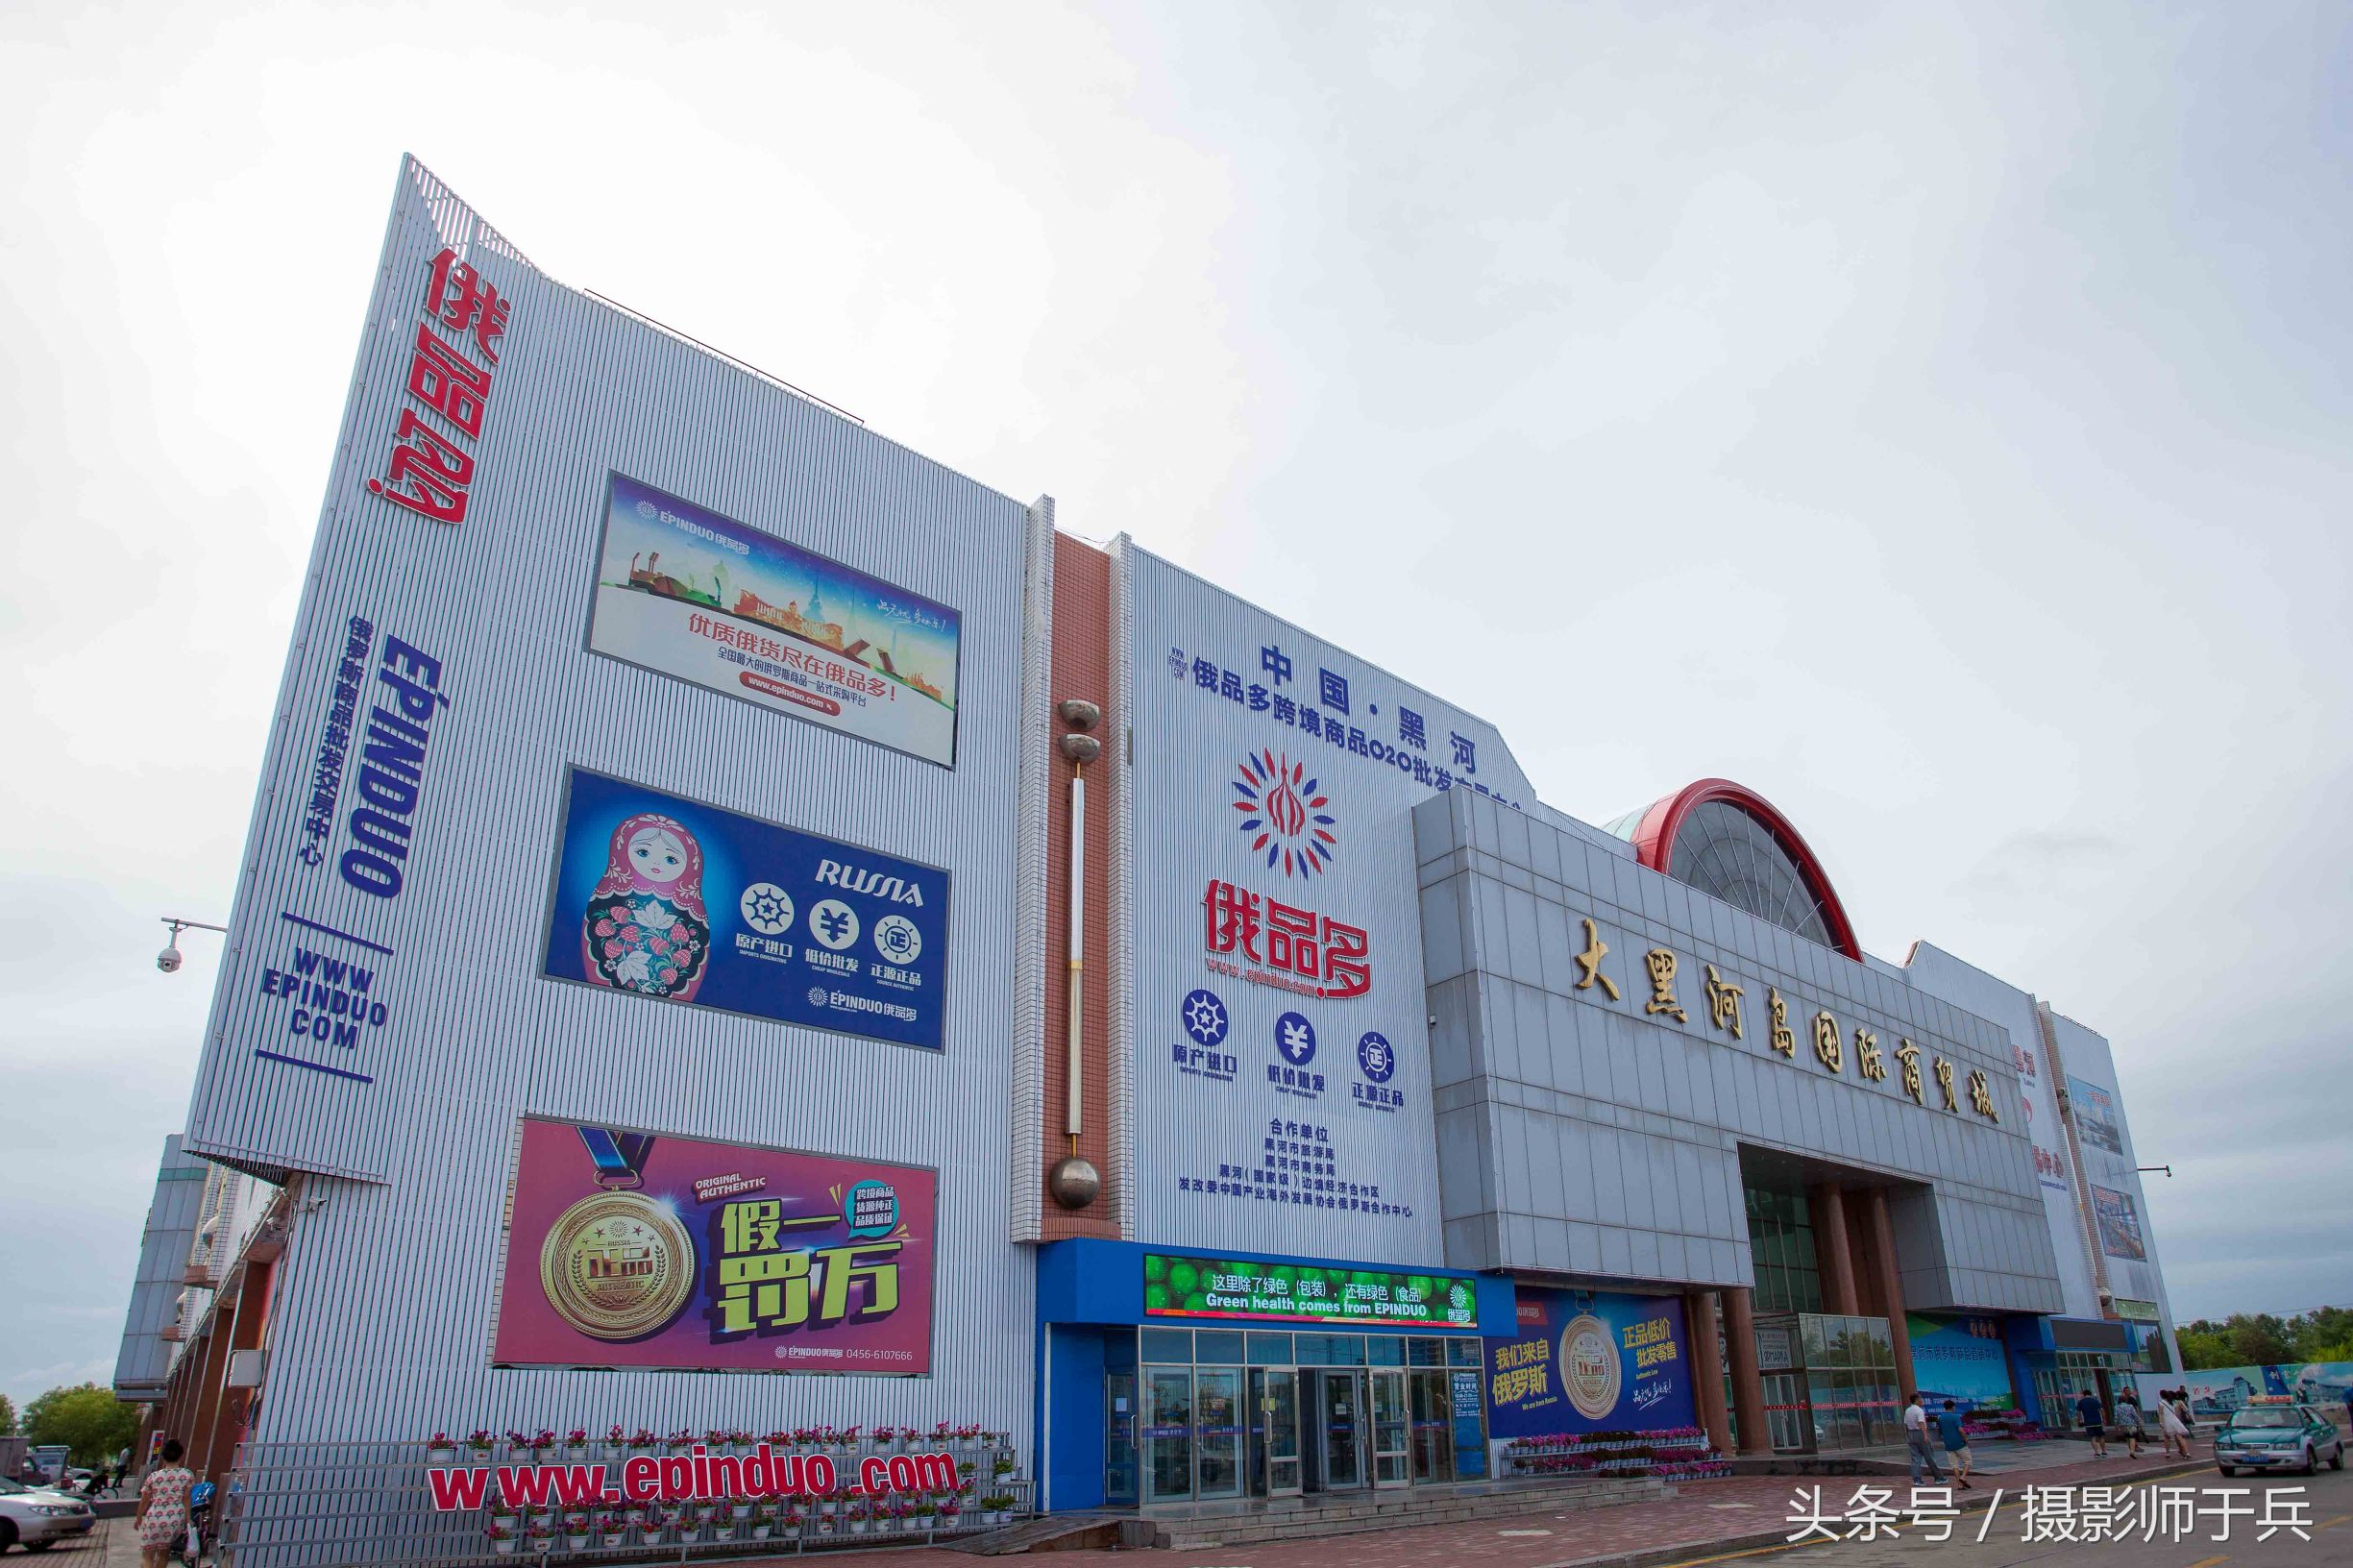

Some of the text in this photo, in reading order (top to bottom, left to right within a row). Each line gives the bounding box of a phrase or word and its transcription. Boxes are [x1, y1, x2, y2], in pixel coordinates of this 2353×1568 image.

[366, 247, 512, 525] 俄品多
[748, 676, 824, 709] www.epinduo.com
[815, 858, 924, 908] RUSSIA
[735, 932, 794, 958] 原产进口
[1202, 877, 1371, 999] 俄品多
[294, 946, 374, 993] WWW
[804, 948, 859, 972] 低价批发
[870, 963, 921, 987] 正源正品
[1206, 957, 1316, 996] www.epinduo.com
[262, 968, 387, 1027] EPINDUO
[290, 1009, 358, 1050] COM
[1173, 1043, 1238, 1074] 原产进口
[1267, 1064, 1325, 1092] 低价批发
[1270, 1118, 1328, 1142] 合作单位
[1264, 1138, 1335, 1161] 黑河市旅游局
[1265, 1154, 1335, 1177] 黑河市商务局
[696, 1173, 742, 1189] ORIGINAL
[699, 1177, 766, 1199] AUTHENTIC
[1206, 1293, 1427, 1317] Green health comes from EPINDUO
[1623, 1316, 1671, 1349] 正品低价
[846, 1349, 913, 1360] 0456-6107666
[1495, 1337, 1550, 1370] 我们来自
[1636, 1341, 1677, 1368] 批发零售
[1492, 1363, 1548, 1407] 俄罗斯
